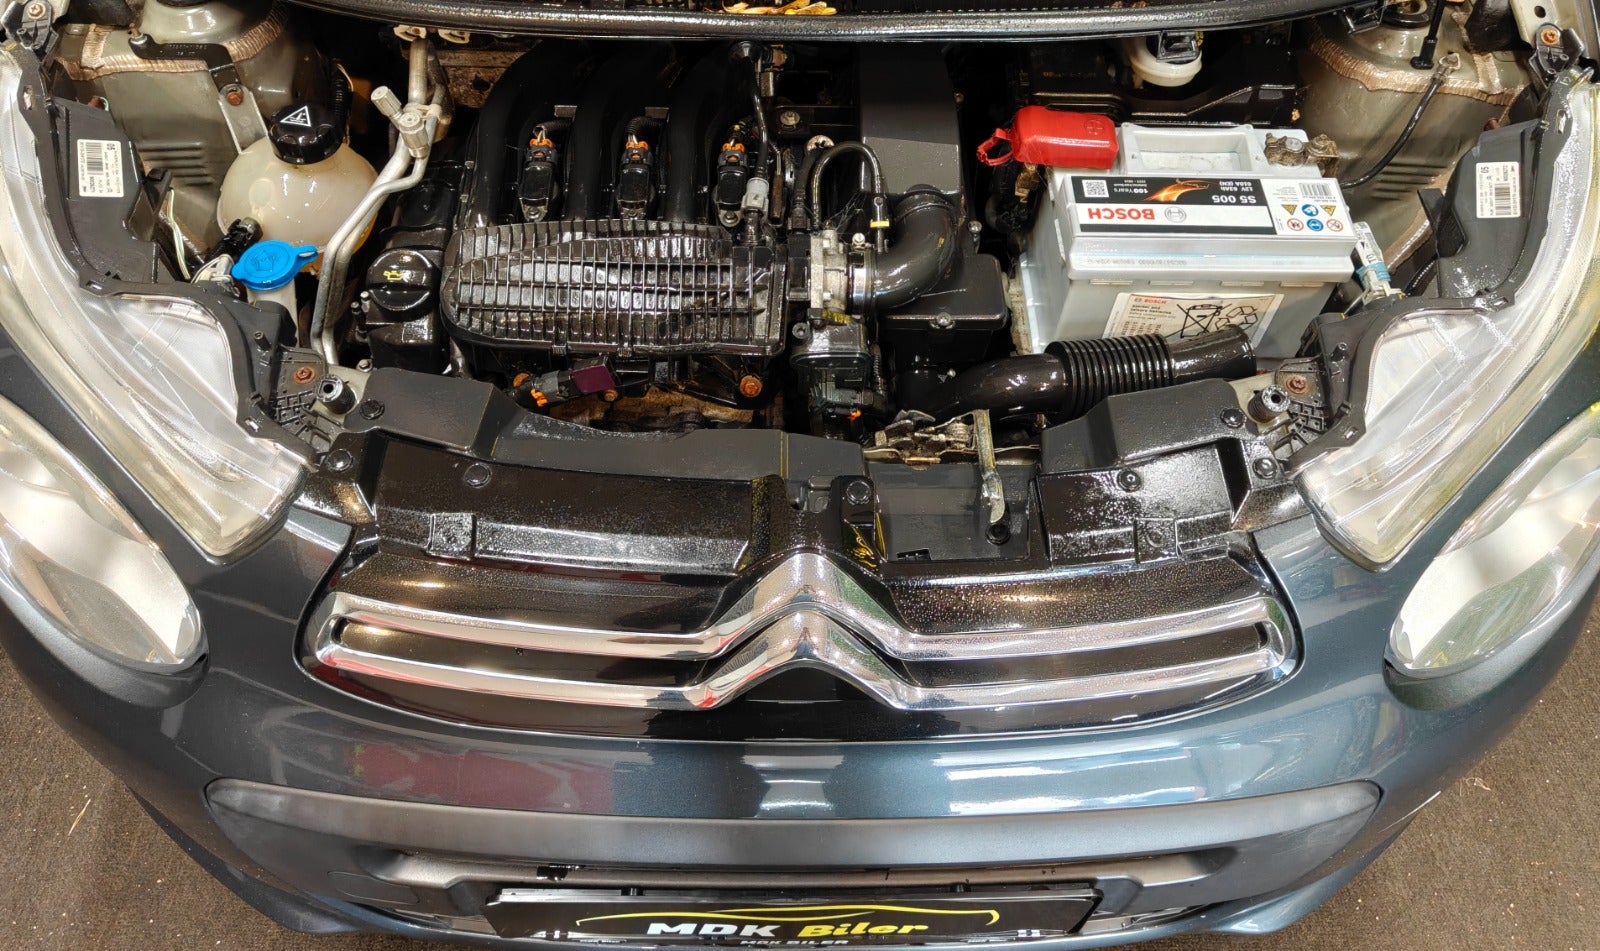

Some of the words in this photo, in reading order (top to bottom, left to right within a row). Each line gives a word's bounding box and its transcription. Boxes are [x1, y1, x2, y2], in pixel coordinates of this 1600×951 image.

[1211, 194, 1236, 204] 005
[1239, 195, 1257, 204] S5
[1087, 207, 1156, 221] BOSCH
[647, 922, 781, 936] MDK
[798, 921, 929, 937] Biler
